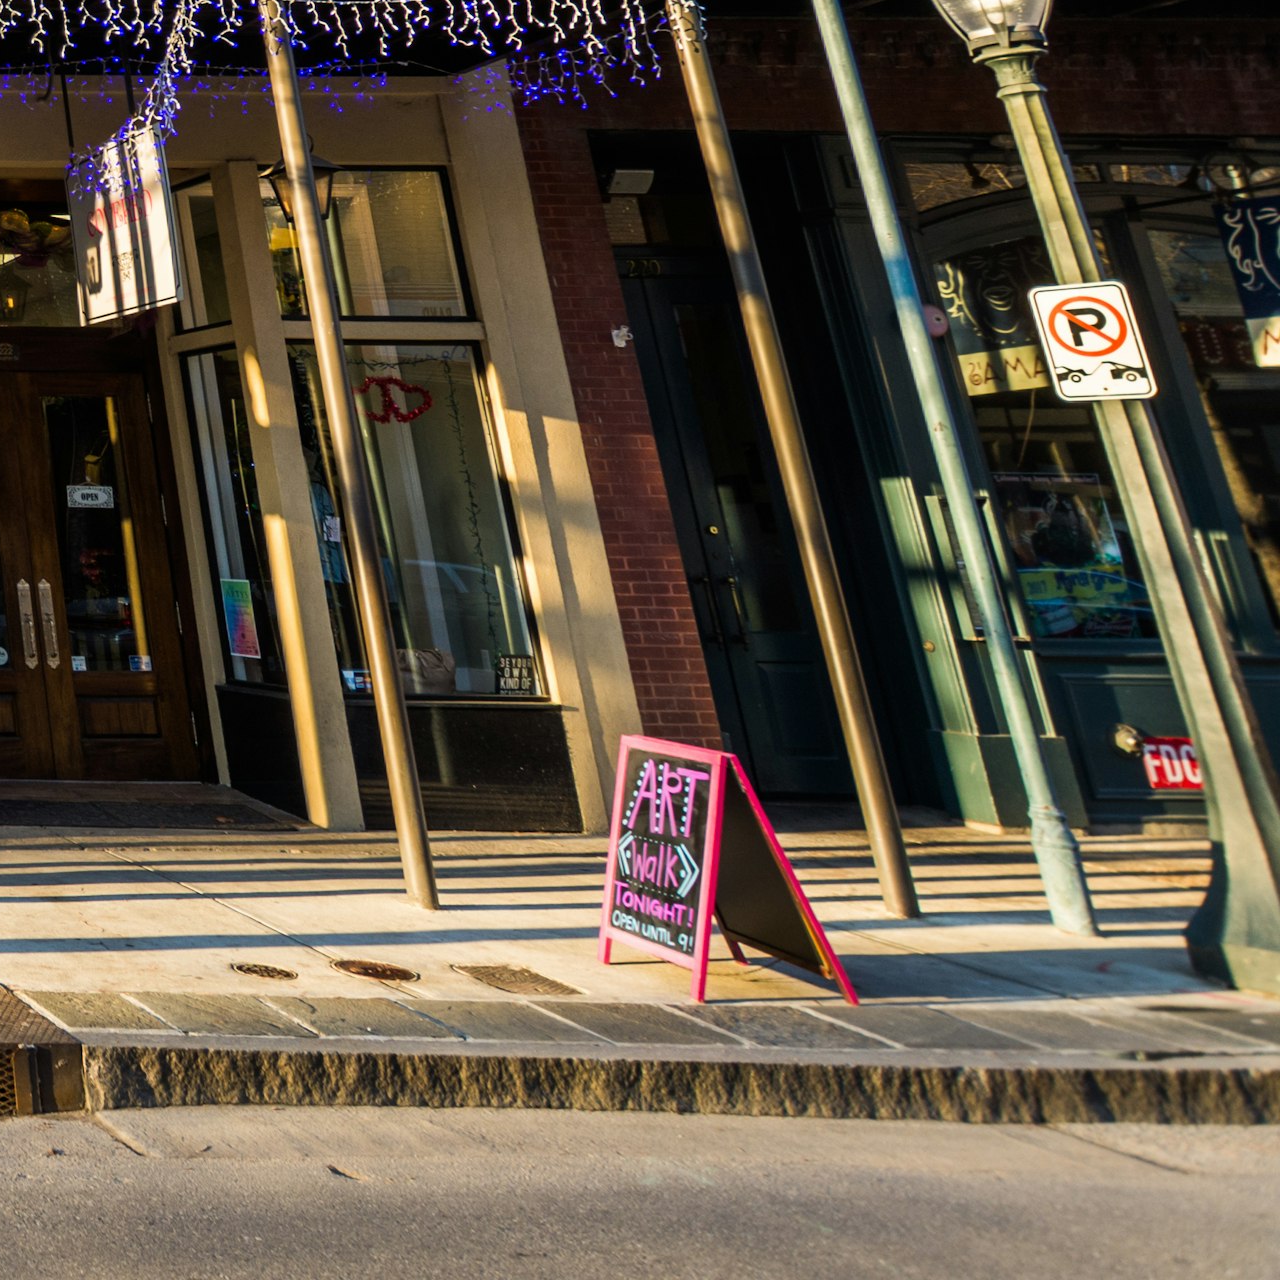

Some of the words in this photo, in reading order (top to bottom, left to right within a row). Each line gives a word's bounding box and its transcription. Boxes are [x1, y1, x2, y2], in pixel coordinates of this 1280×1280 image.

[80, 493, 99, 501] OPEN
[500, 677, 520, 689] KIND
[521, 677, 531, 689] OF
[504, 667, 528, 678] OWN
[1143, 744, 1202, 784] FDC
[627, 758, 710, 838] ART
[631, 838, 680, 888] Walk
[611, 909, 641, 936] OPEN
[641, 923, 676, 947] UNTIL
